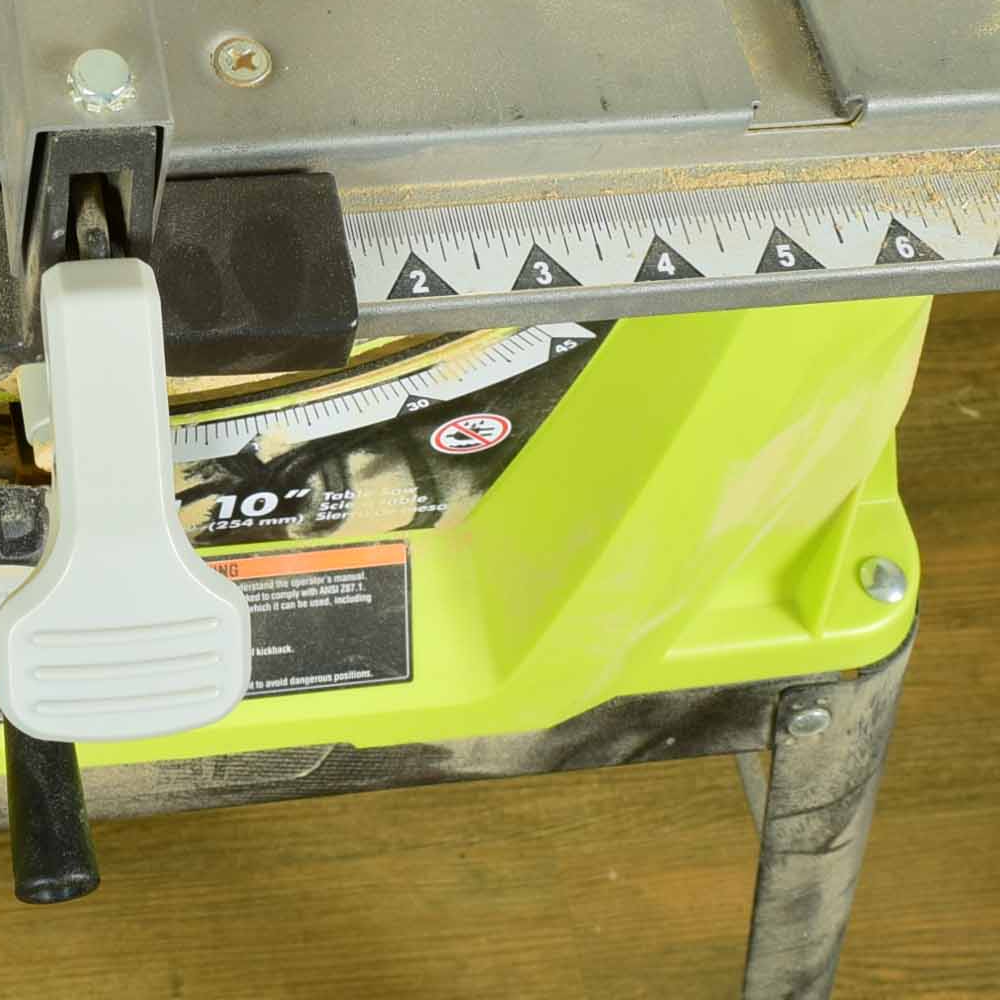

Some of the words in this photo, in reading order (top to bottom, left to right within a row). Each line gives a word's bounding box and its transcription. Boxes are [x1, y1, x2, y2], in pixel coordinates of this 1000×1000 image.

[775, 243, 796, 268] 5
[895, 235, 915, 259] 6
[533, 260, 553, 286] 3
[656, 252, 676, 276] 4
[408, 269, 431, 294] 2
[554, 338, 578, 354] 45
[406, 398, 430, 413] 30
[215, 488, 312, 519] 10"
[324, 489, 367, 501] Tab
[208, 519, 254, 532] (254
[259, 513, 304, 526] mm)
[262, 591, 270, 600] to
[271, 589, 299, 601] comply
[301, 587, 318, 597] with
[319, 584, 339, 595] ANSI
[275, 578, 289, 589] the
[273, 601, 279, 611] it
[280, 601, 296, 610] can
[297, 599, 308, 609] be
[309, 597, 332, 608] used,
[334, 593, 372, 605] including
[255, 679, 264, 689] to
[265, 676, 288, 688] avoid
[289, 672, 332, 687] dangerous
[333, 670, 374, 684] positions.
